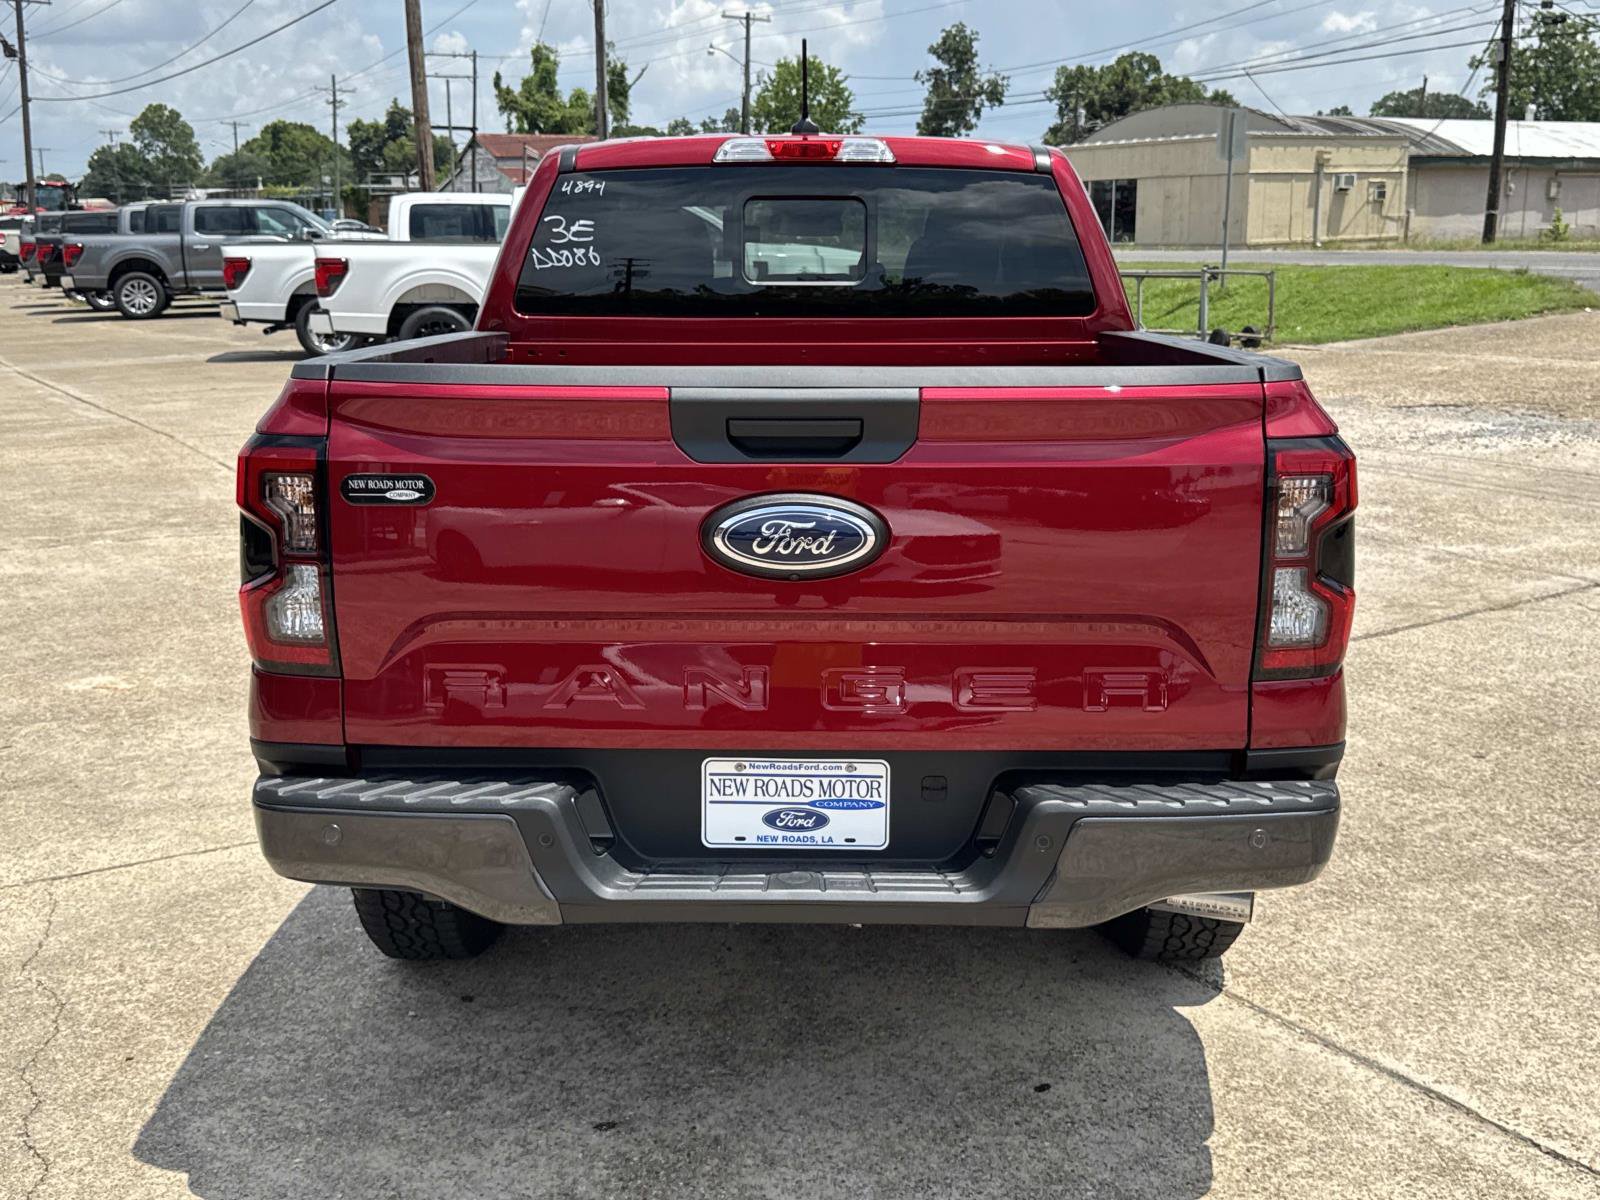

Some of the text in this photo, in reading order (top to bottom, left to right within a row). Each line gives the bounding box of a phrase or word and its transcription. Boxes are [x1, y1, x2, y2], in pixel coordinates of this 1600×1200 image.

[543, 215, 596, 244] 3E
[348, 480, 425, 489] NEW ROADS MOTOR
[752, 519, 837, 555] Ford
[423, 663, 1168, 713] RANGER
[749, 763, 843, 771] NewRoadsFord.com
[709, 778, 882, 799] NEW ROADS MOTOR
[775, 811, 817, 828] Ford
[756, 835, 834, 845] NEW ROADS, LA
